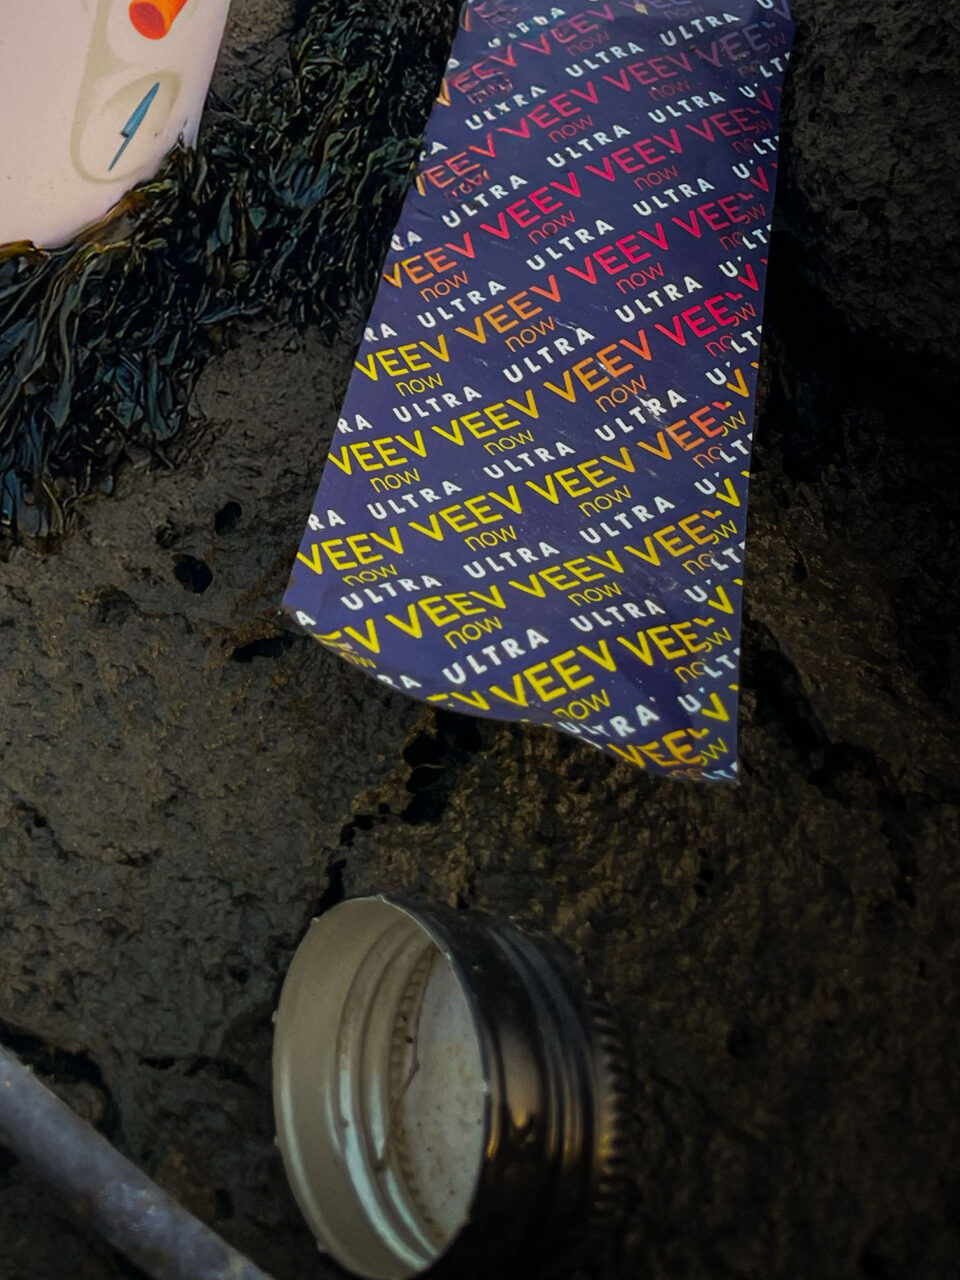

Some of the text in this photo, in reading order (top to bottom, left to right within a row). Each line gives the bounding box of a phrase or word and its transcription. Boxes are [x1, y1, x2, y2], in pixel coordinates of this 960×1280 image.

[565, 41, 645, 79] ULTRA
[659, 12, 741, 47] ULTRA
[496, 81, 599, 140] VEEV
[602, 52, 692, 92] VEEV
[547, 124, 631, 168] ULTRA
[648, 91, 727, 124] ULTRA
[548, 79, 691, 145] now now
[442, 174, 528, 228] ULTRA
[526, 219, 615, 271] ULTRA
[633, 177, 715, 216] ULTRA
[480, 172, 582, 240] VEEV
[585, 128, 683, 183] VEEV
[528, 210, 576, 245] now
[634, 164, 678, 190] now
[383, 232, 475, 288] VEEV
[565, 222, 669, 286] VEEV
[420, 271, 469, 303] now
[616, 262, 665, 294] now
[355, 334, 450, 381] VEEV
[455, 274, 561, 344] VEEV
[395, 373, 444, 397] now
[505, 316, 556, 352] now
[417, 280, 507, 329] ULTRA
[503, 327, 596, 383] ULTRA
[615, 276, 703, 323] ULTRA
[328, 329, 652, 476] VEEV VEEV VEEV
[370, 374, 647, 493] now now now
[392, 386, 483, 422] ULTRA
[484, 441, 576, 479] ULTRA
[595, 389, 688, 442] ULTRA
[296, 526, 404, 575] VEEV
[408, 485, 522, 542] VEEV
[525, 447, 635, 505] VEEV
[343, 564, 398, 587] now
[464, 525, 518, 552] now
[579, 485, 632, 517] now
[367, 481, 462, 520] ULTRA
[463, 541, 560, 578] ULTRA
[579, 496, 676, 544] ULTRA
[341, 575, 442, 610] ULTRA
[443, 628, 550, 685] ULTRA
[570, 599, 666, 632] ULTRA
[385, 585, 506, 639] VEEV
[508, 550, 624, 598] VEEV
[444, 616, 502, 649] now
[568, 582, 622, 607] now
[489, 639, 617, 707] VEEV
[552, 689, 611, 721] now
